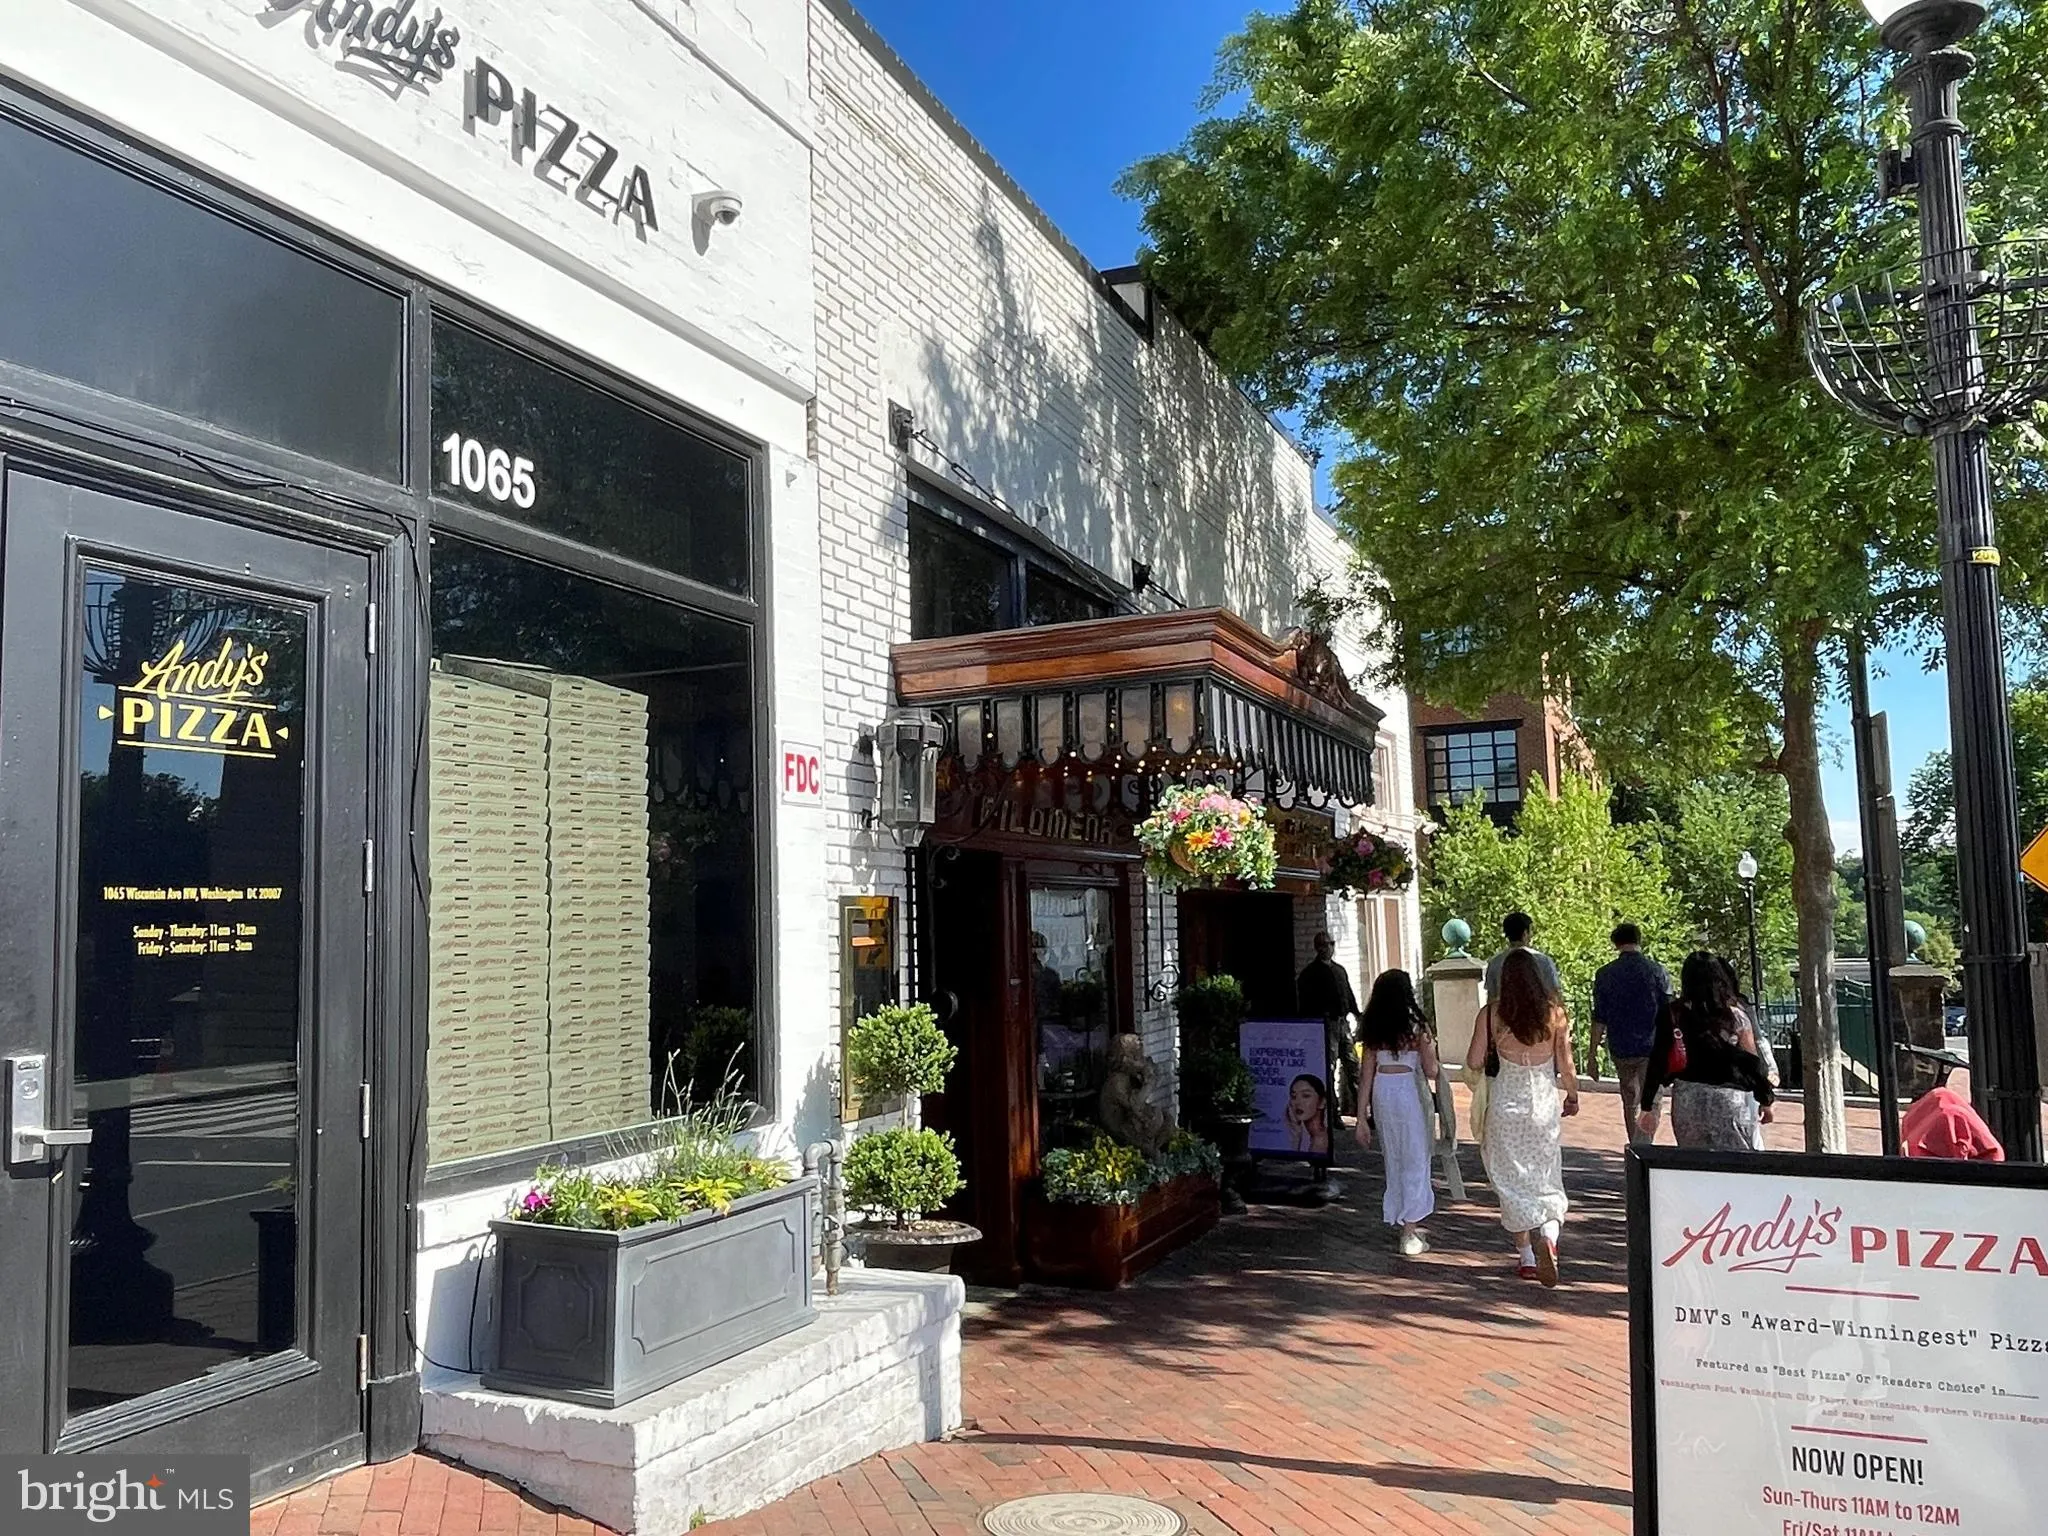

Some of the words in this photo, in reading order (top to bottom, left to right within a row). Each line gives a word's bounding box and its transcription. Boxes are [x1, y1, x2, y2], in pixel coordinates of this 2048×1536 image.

[470, 57, 659, 236] PIZZA
[443, 432, 536, 509] 1065
[134, 637, 269, 700] Andy's
[122, 696, 272, 749] PIZZA
[785, 752, 820, 795] FDC
[103, 887, 125, 900] 1065
[126, 887, 166, 900] Wisconsin
[167, 888, 181, 900] Ave
[183, 888, 199, 902] NW,
[200, 887, 244, 902] Washington
[247, 888, 258, 900] DC
[259, 887, 282, 900] 20007
[133, 925, 164, 940] Sunday
[169, 924, 208, 939] Thursday:
[209, 924, 231, 936] 11am
[138, 941, 164, 957] Friday
[170, 940, 207, 955] Saturday:
[209, 940, 230, 952] 11am
[1249, 1047, 1306, 1058] EXPERIENCE
[1287, 1058, 1307, 1068] LIKE
[1661, 1193, 1843, 1274] Andy's
[1850, 1226, 2048, 1277] PIZZA
[1675, 1306, 1731, 1326] DMV's
[1741, 1310, 1978, 1347] "Award-Winningest"
[1989, 1332, 2048, 1354] Pizz
[1659, 1378, 1711, 1392] Washington
[1739, 1386, 1792, 1400] Washington
[1796, 1392, 1816, 1403] City
[1695, 1358, 1749, 1372] Featured
[1754, 1366, 1768, 1374] as
[1772, 1365, 1806, 1378] "Best
[1811, 1369, 1851, 1382] Pizza"
[1856, 1373, 1871, 1384] Or
[1875, 1374, 1933, 1390] "Readers
[1938, 1381, 1985, 1395] Choice"
[1791, 1446, 1845, 1477] NOW
[1853, 1453, 1924, 1486] OPEN!
[1763, 1486, 1848, 1513] Sun-Thurs
[1851, 1496, 1890, 1518] 11AM
[1895, 1500, 1913, 1520] to
[1917, 1504, 1961, 1527] 12AM
